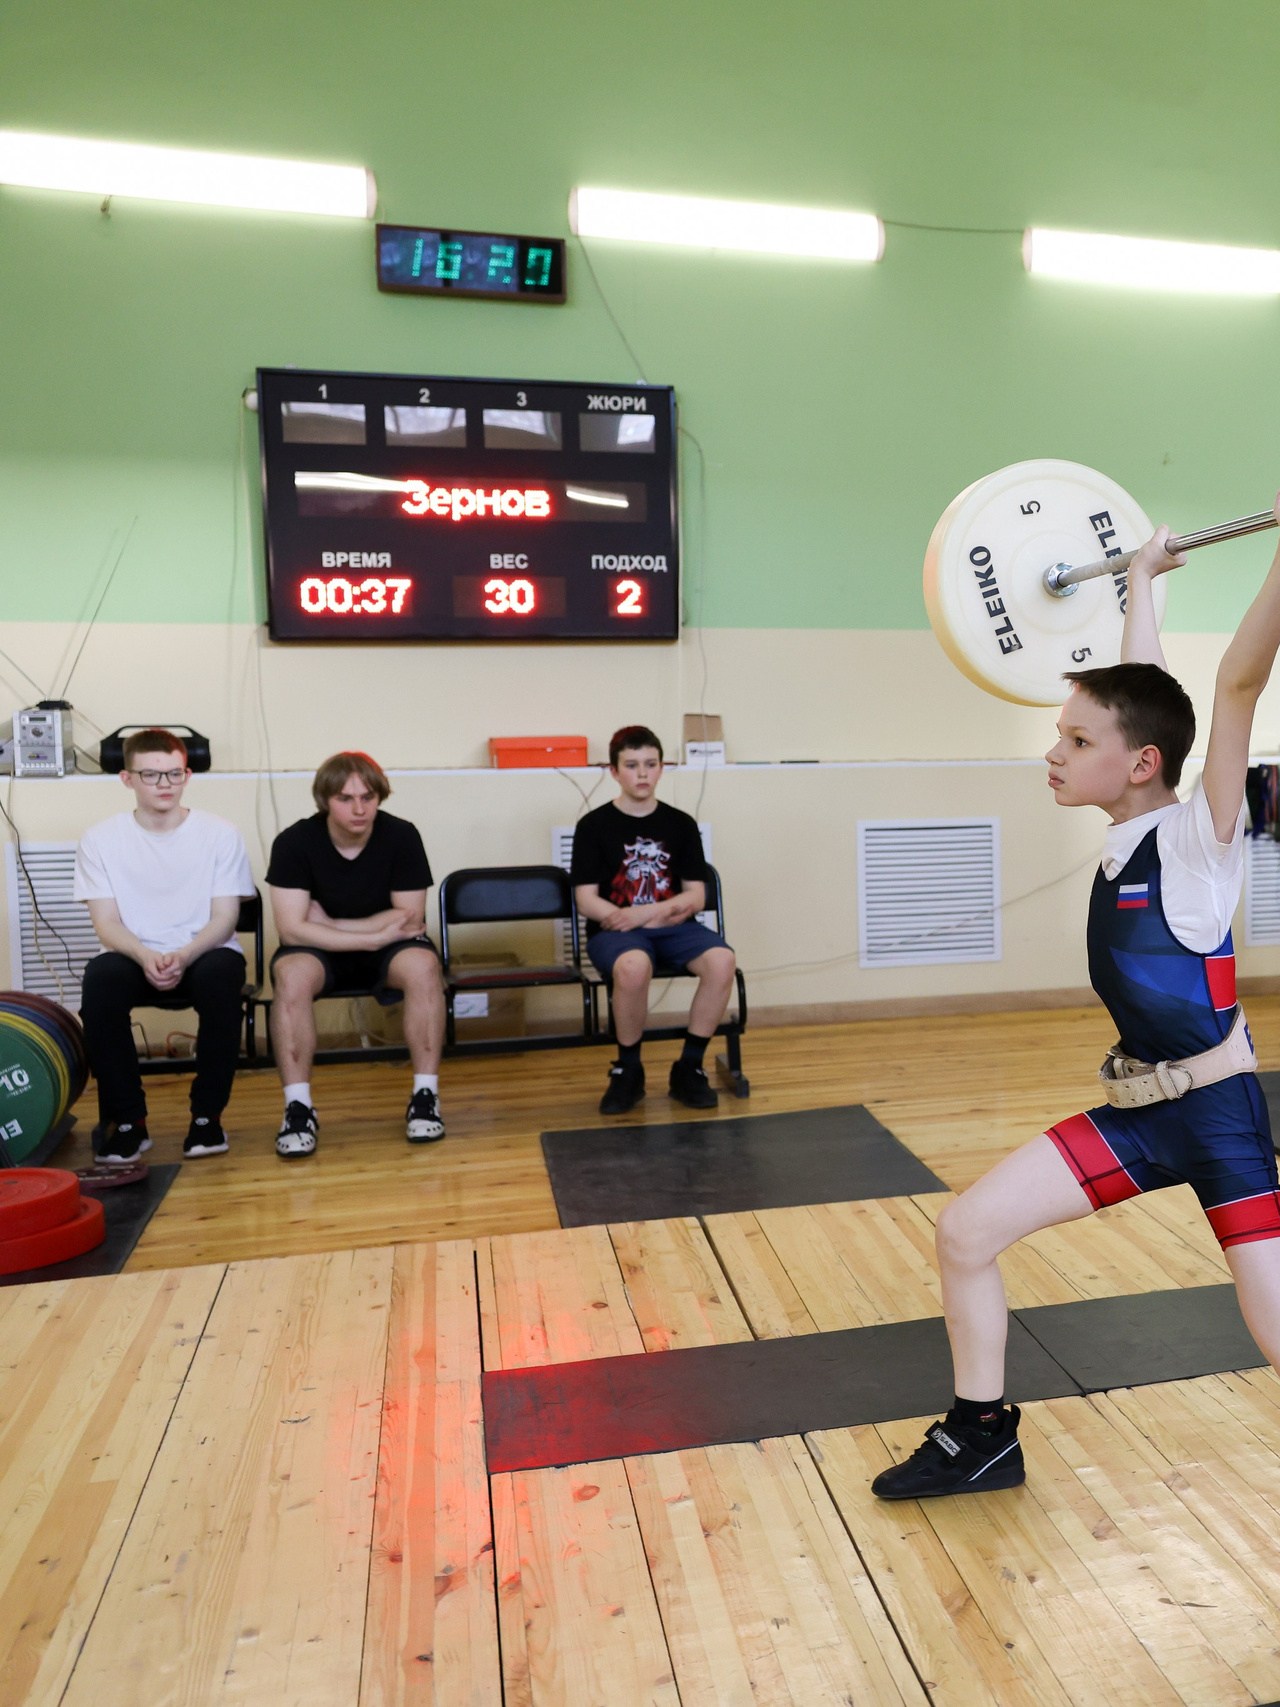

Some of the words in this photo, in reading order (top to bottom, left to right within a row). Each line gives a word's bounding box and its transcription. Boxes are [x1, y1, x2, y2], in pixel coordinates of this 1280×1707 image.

[317, 384, 328, 400] 1
[418, 387, 431, 403] 2
[516, 391, 528, 407] 3
[587, 394, 647, 412] ЖЮРИ
[402, 479, 551, 521] Зернов
[1020, 500, 1041, 516] 5
[321, 551, 392, 568] ВРЕМЯ
[489, 553, 529, 570] ВЕС
[591, 554, 668, 572] ПОДХОД
[300, 577, 412, 613] 00:37
[484, 579, 535, 614] 30
[615, 579, 642, 615] 2
[969, 545, 1024, 655] ELEIKO
[1071, 646, 1093, 664] 5
